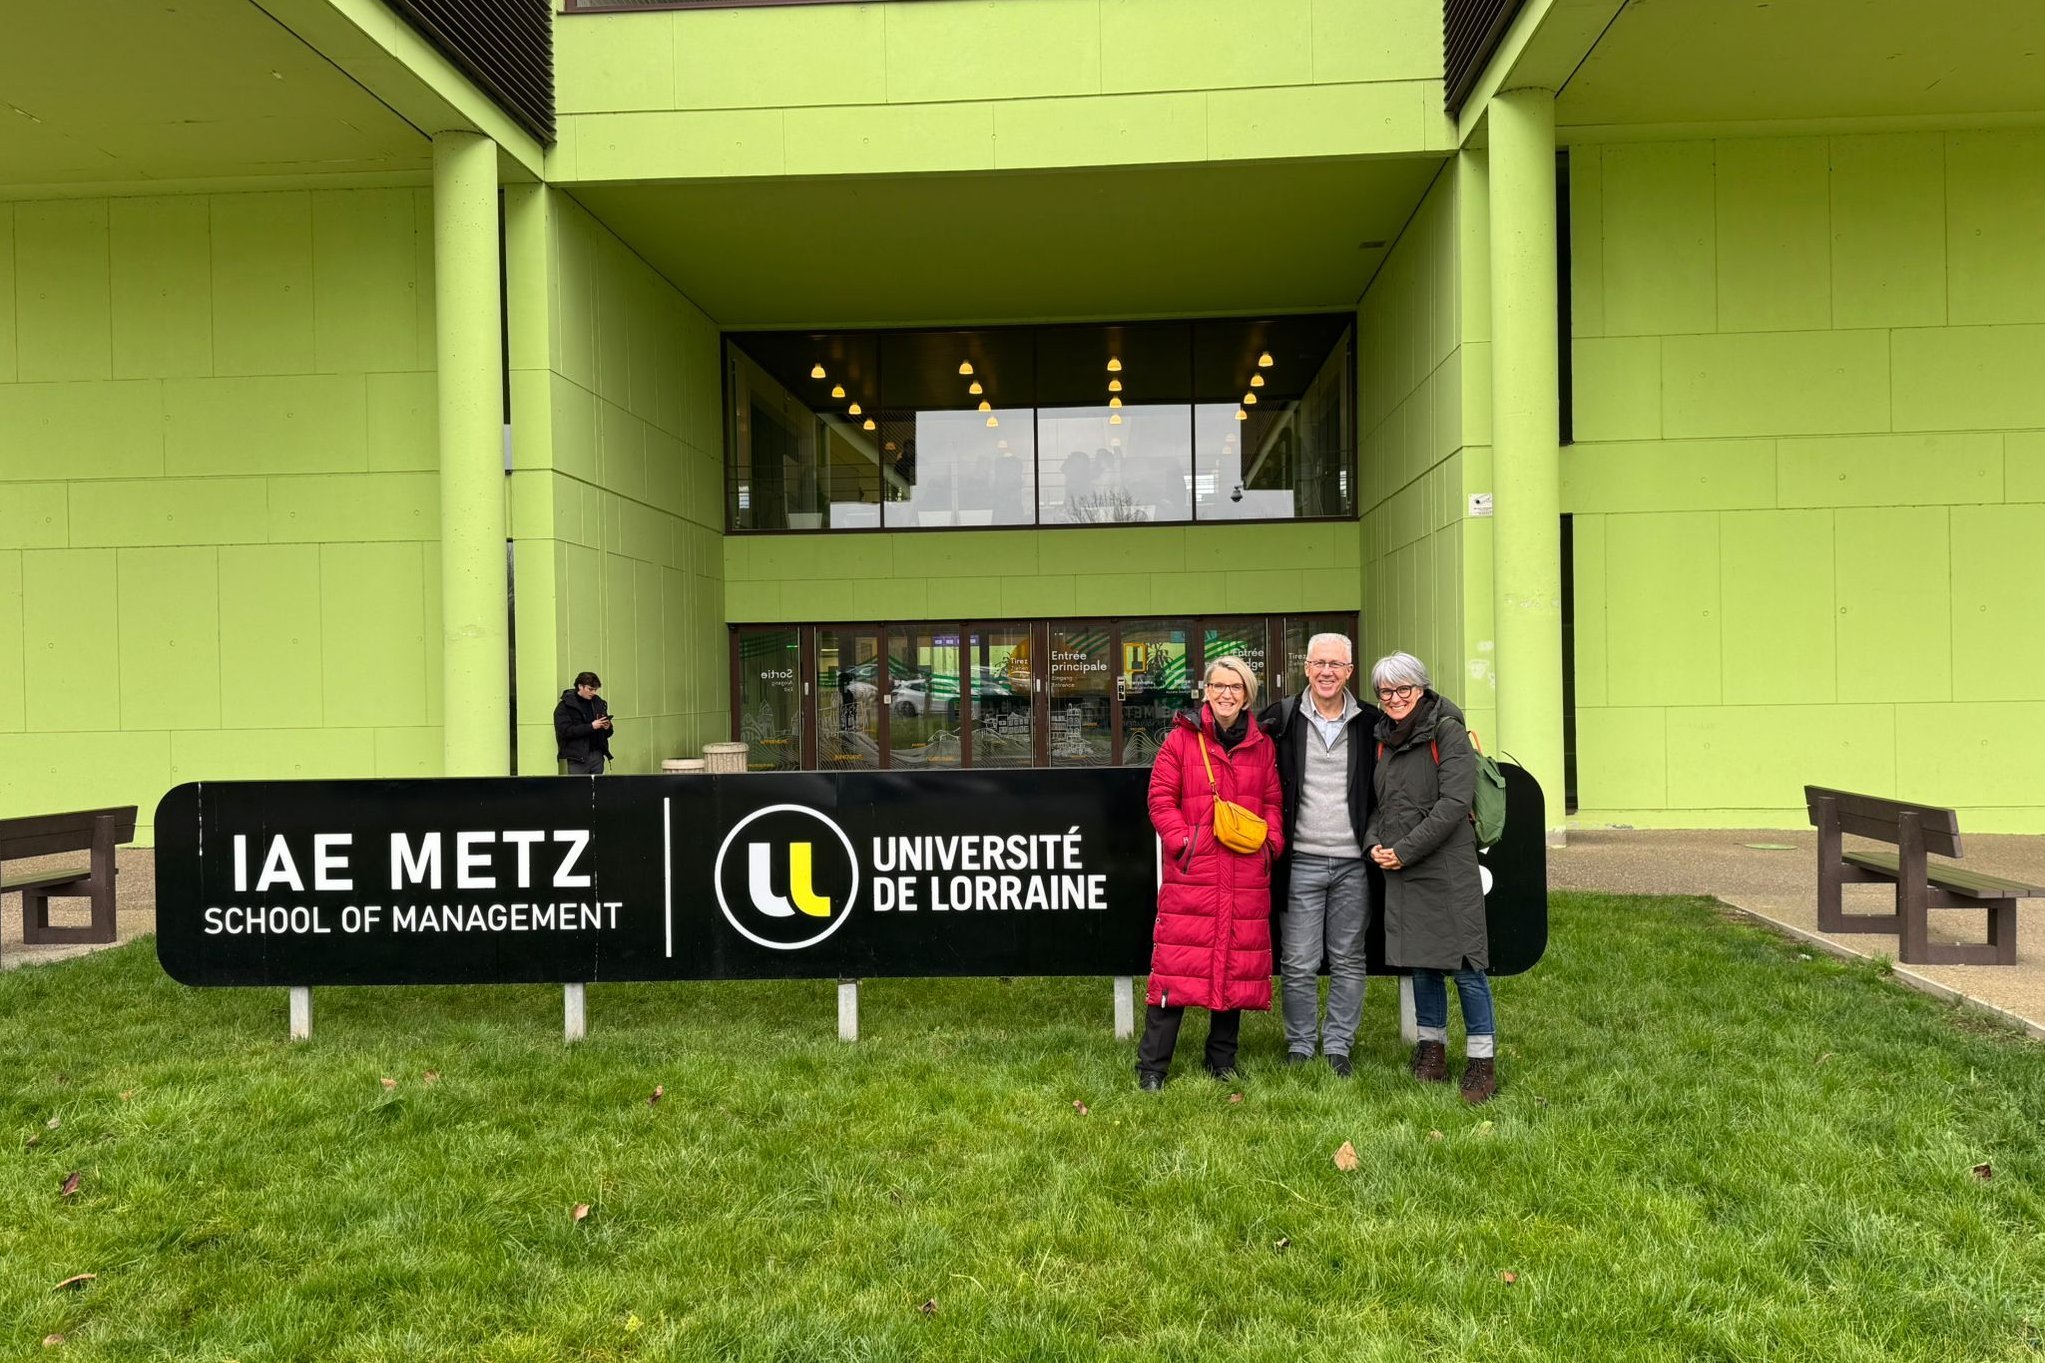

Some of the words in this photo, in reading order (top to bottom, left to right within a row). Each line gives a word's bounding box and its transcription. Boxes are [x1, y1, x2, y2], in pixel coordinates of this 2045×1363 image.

[1051, 650, 1087, 661] Entrée
[1232, 648, 1265, 657] Entrée
[1010, 657, 1029, 665] Tirez
[1051, 659, 1108, 674] principale
[1246, 658, 1265, 671] dge
[873, 825, 1083, 872] UNIVERSITÉ
[233, 833, 353, 892] IAE
[390, 829, 592, 890] METZ
[873, 876, 918, 912] DE
[931, 874, 1108, 911] LORRAINE
[204, 905, 333, 935] SCHOOL
[341, 905, 382, 933] OF
[392, 901, 623, 933] MANAGEMENT
